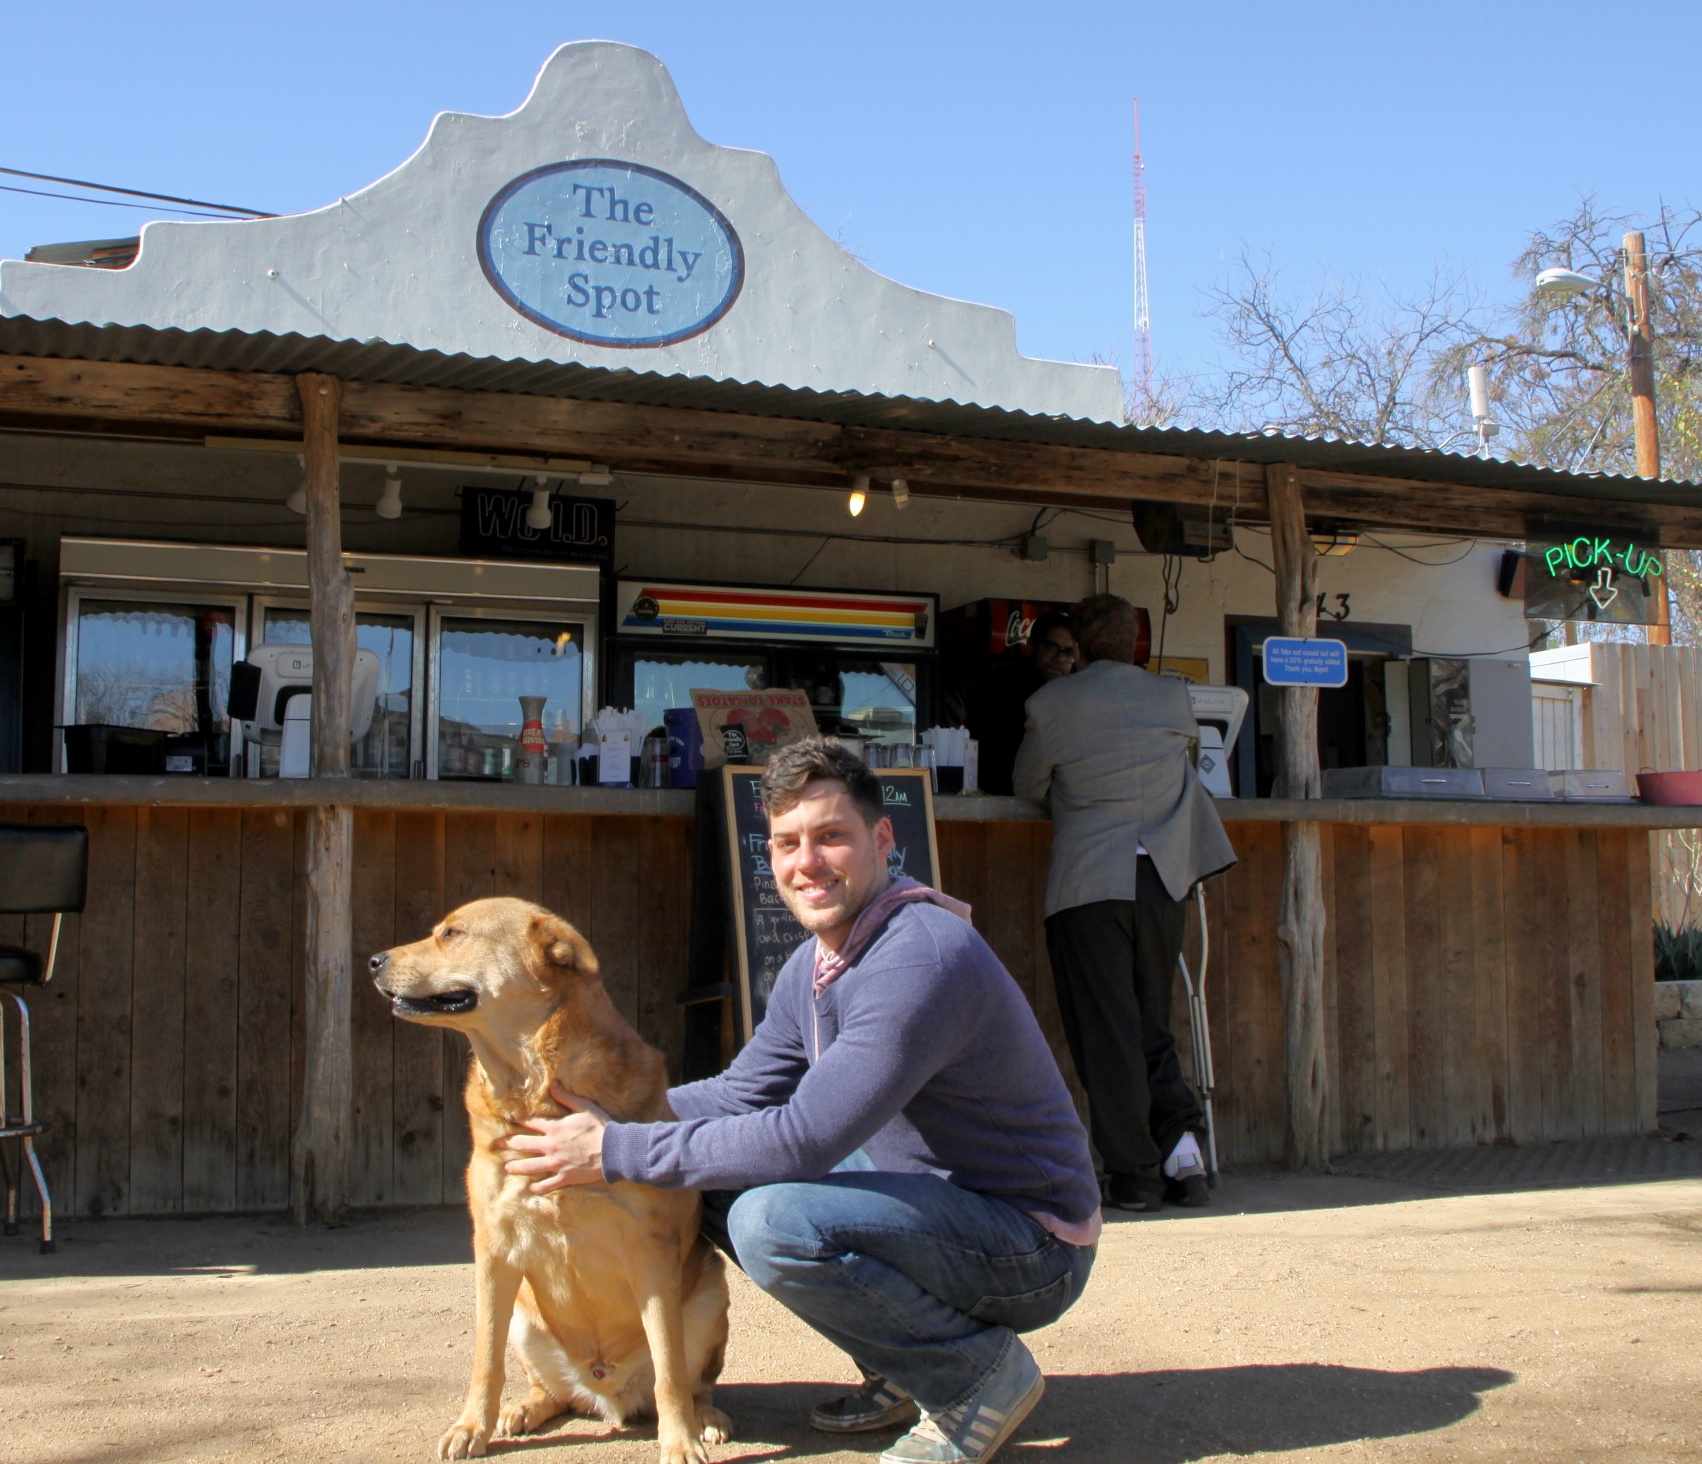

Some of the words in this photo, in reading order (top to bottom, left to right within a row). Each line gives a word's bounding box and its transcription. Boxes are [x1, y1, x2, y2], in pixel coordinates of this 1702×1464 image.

[573, 183, 654, 226] The
[522, 222, 702, 283] Friendly
[567, 273, 661, 319] Spot
[1545, 537, 1663, 579] PICK-UP
